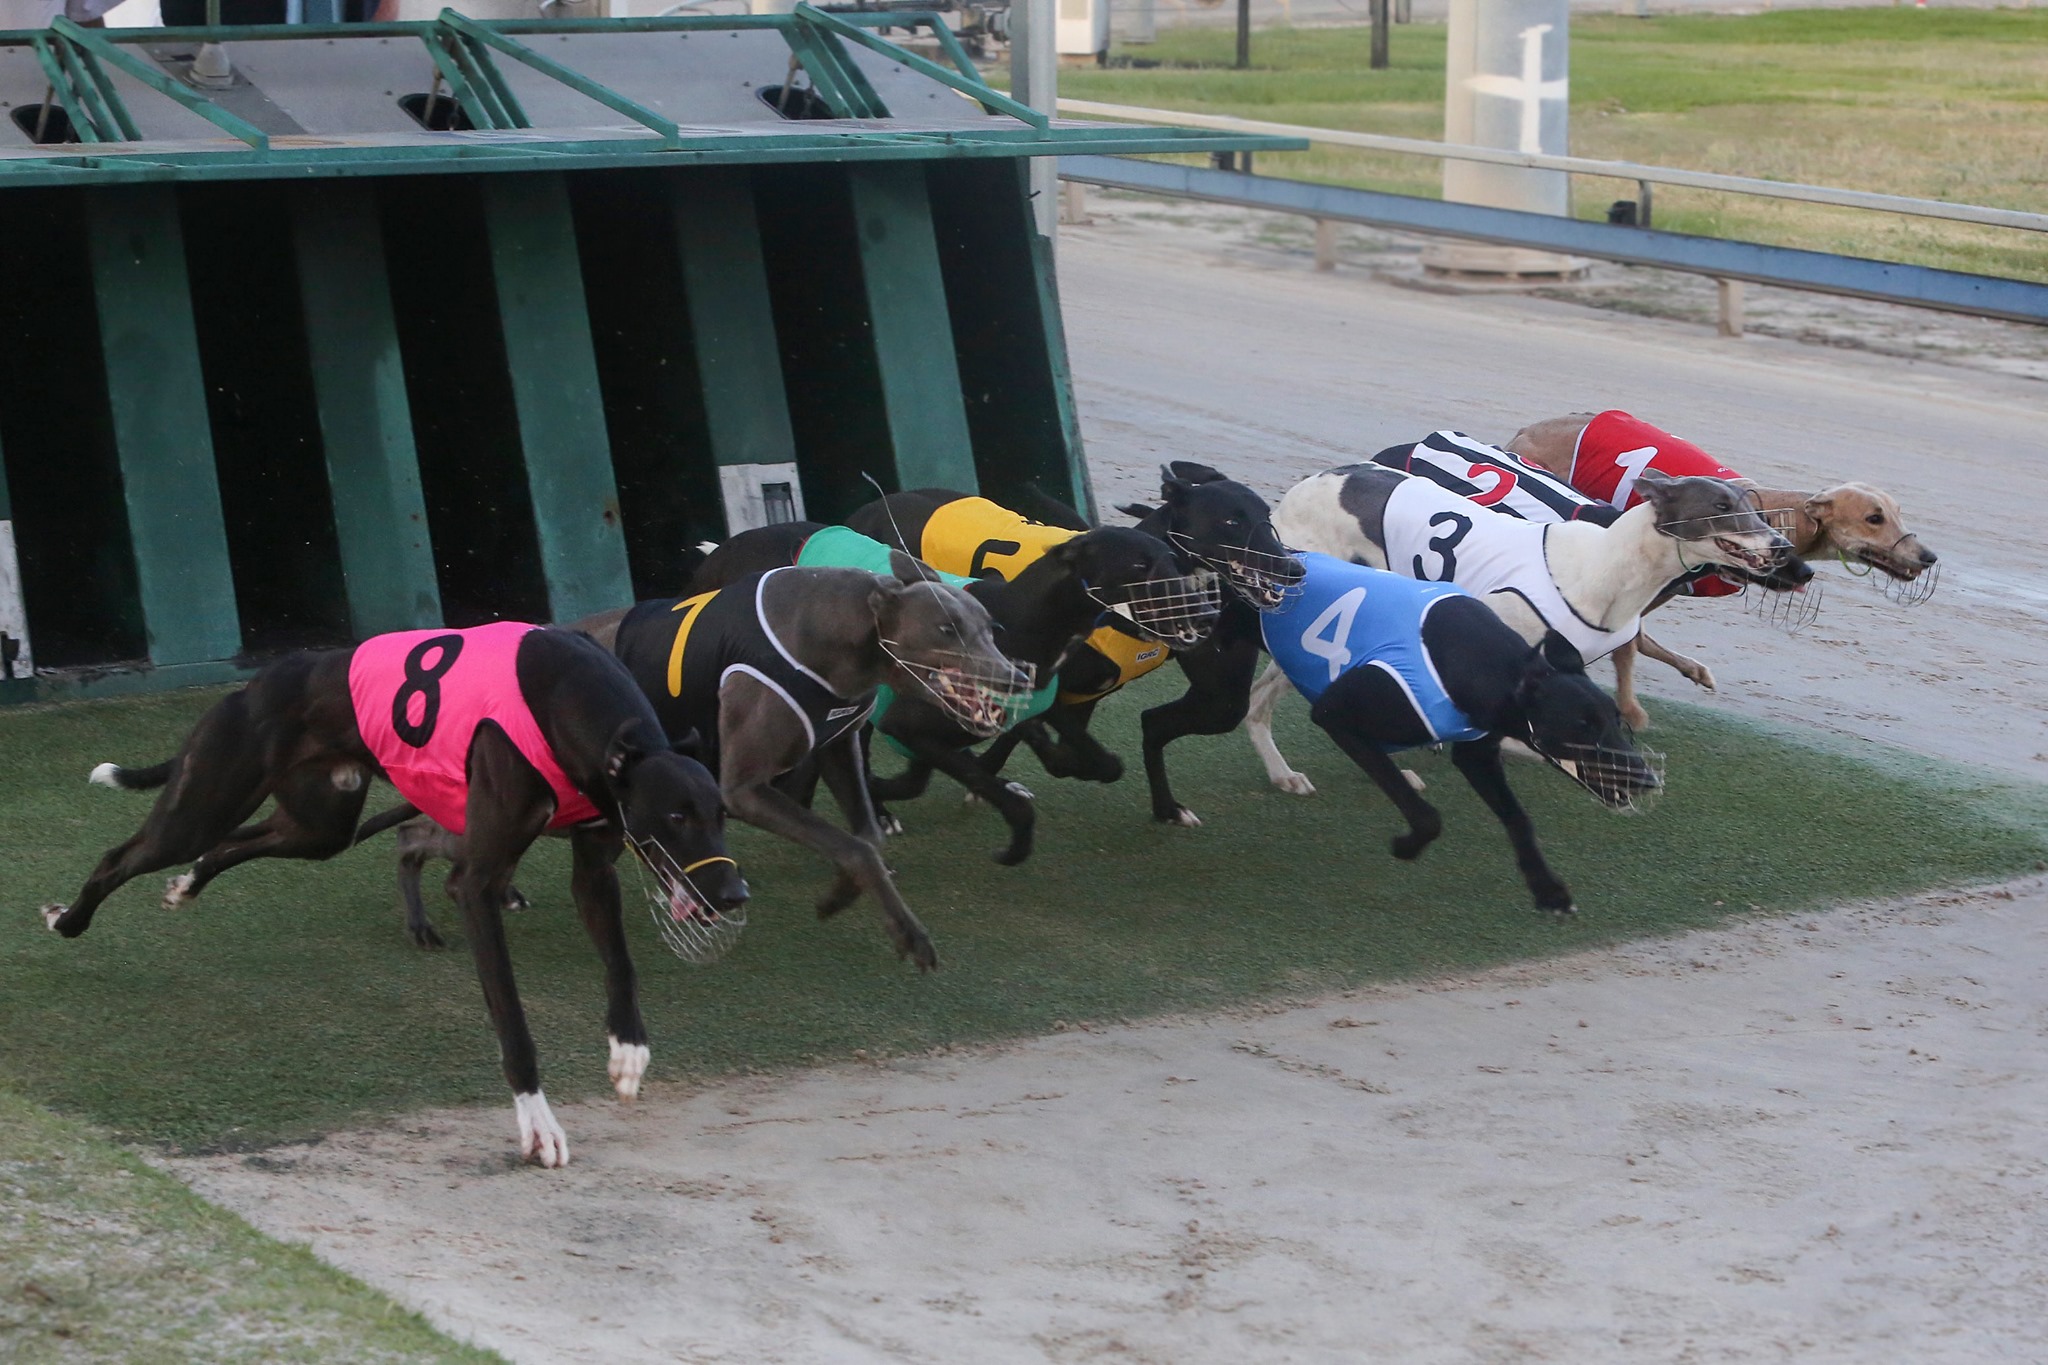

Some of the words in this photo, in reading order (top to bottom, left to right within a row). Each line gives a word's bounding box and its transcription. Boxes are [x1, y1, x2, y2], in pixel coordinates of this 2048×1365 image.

[1615, 446, 1658, 512] 1
[1413, 511, 1474, 582] 3
[667, 588, 722, 697] 7
[1301, 587, 1367, 682] 4
[393, 634, 464, 749] 8
